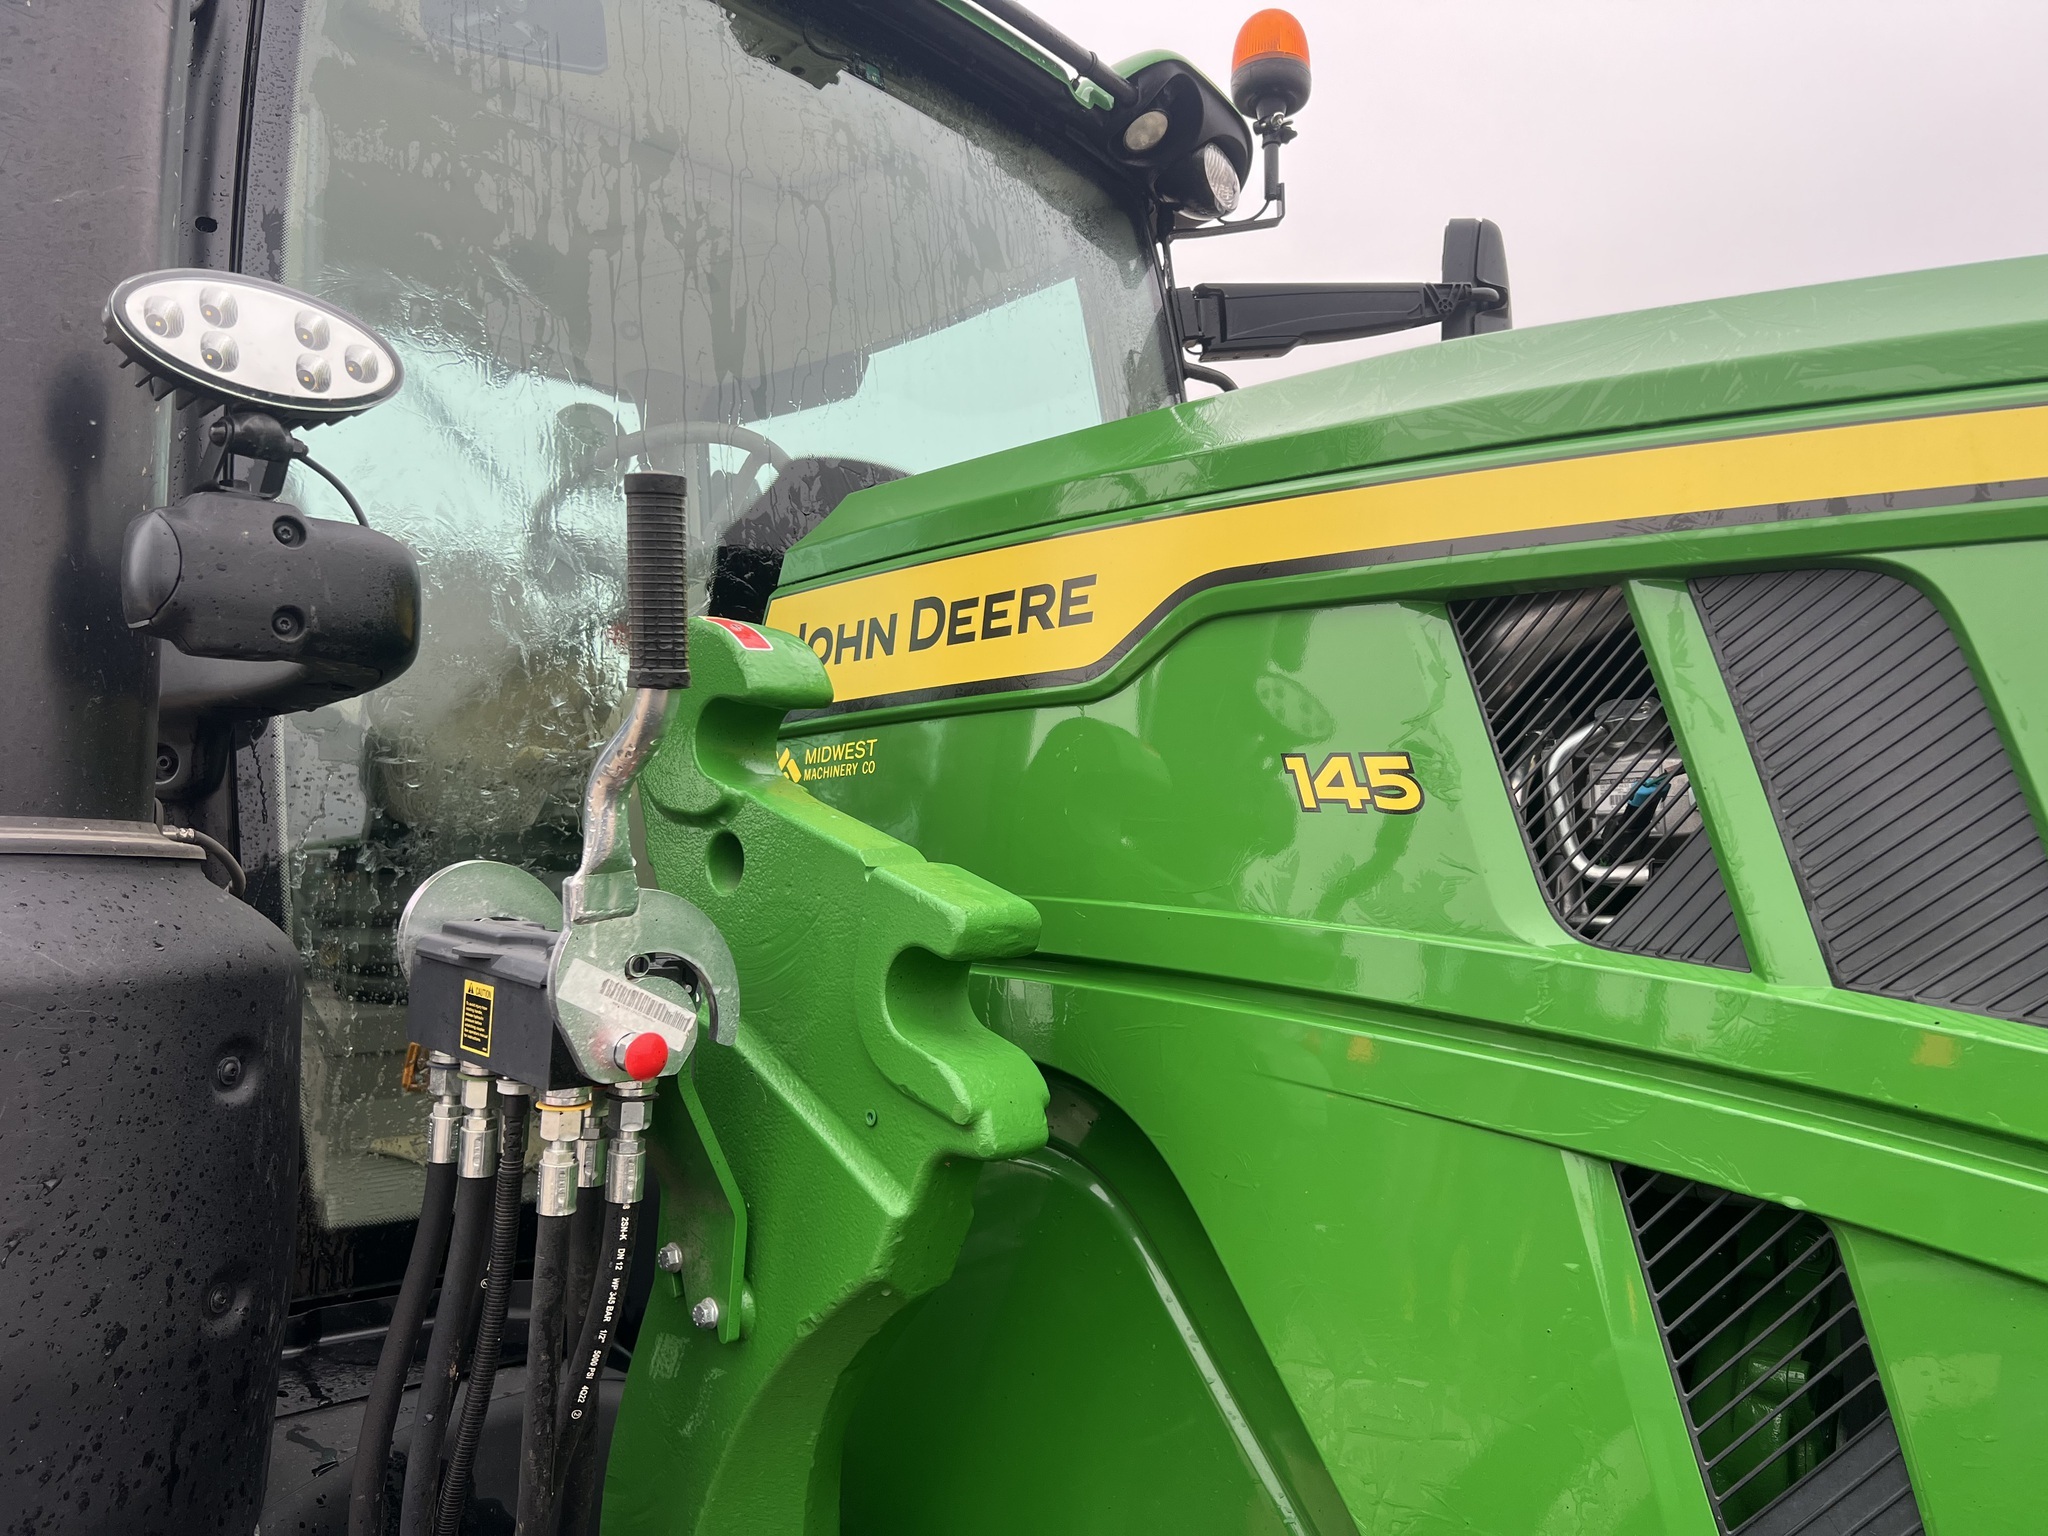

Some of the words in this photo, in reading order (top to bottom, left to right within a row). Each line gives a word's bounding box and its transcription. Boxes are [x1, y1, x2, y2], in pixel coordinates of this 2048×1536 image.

[908, 573, 1098, 653] DEERE
[805, 739, 878, 765] MIDWEST
[803, 762, 858, 781] MACHINERY
[862, 760, 876, 775] CO
[1281, 752, 1425, 815] 145
[619, 1216, 630, 1241] 2SN-K
[616, 1247, 626, 1260] DN
[614, 1261, 624, 1271] 12
[611, 1277, 621, 1291] WP
[603, 1305, 615, 1323] BAR
[590, 1349, 602, 1367] 5000
[585, 1366, 597, 1380] PSI
